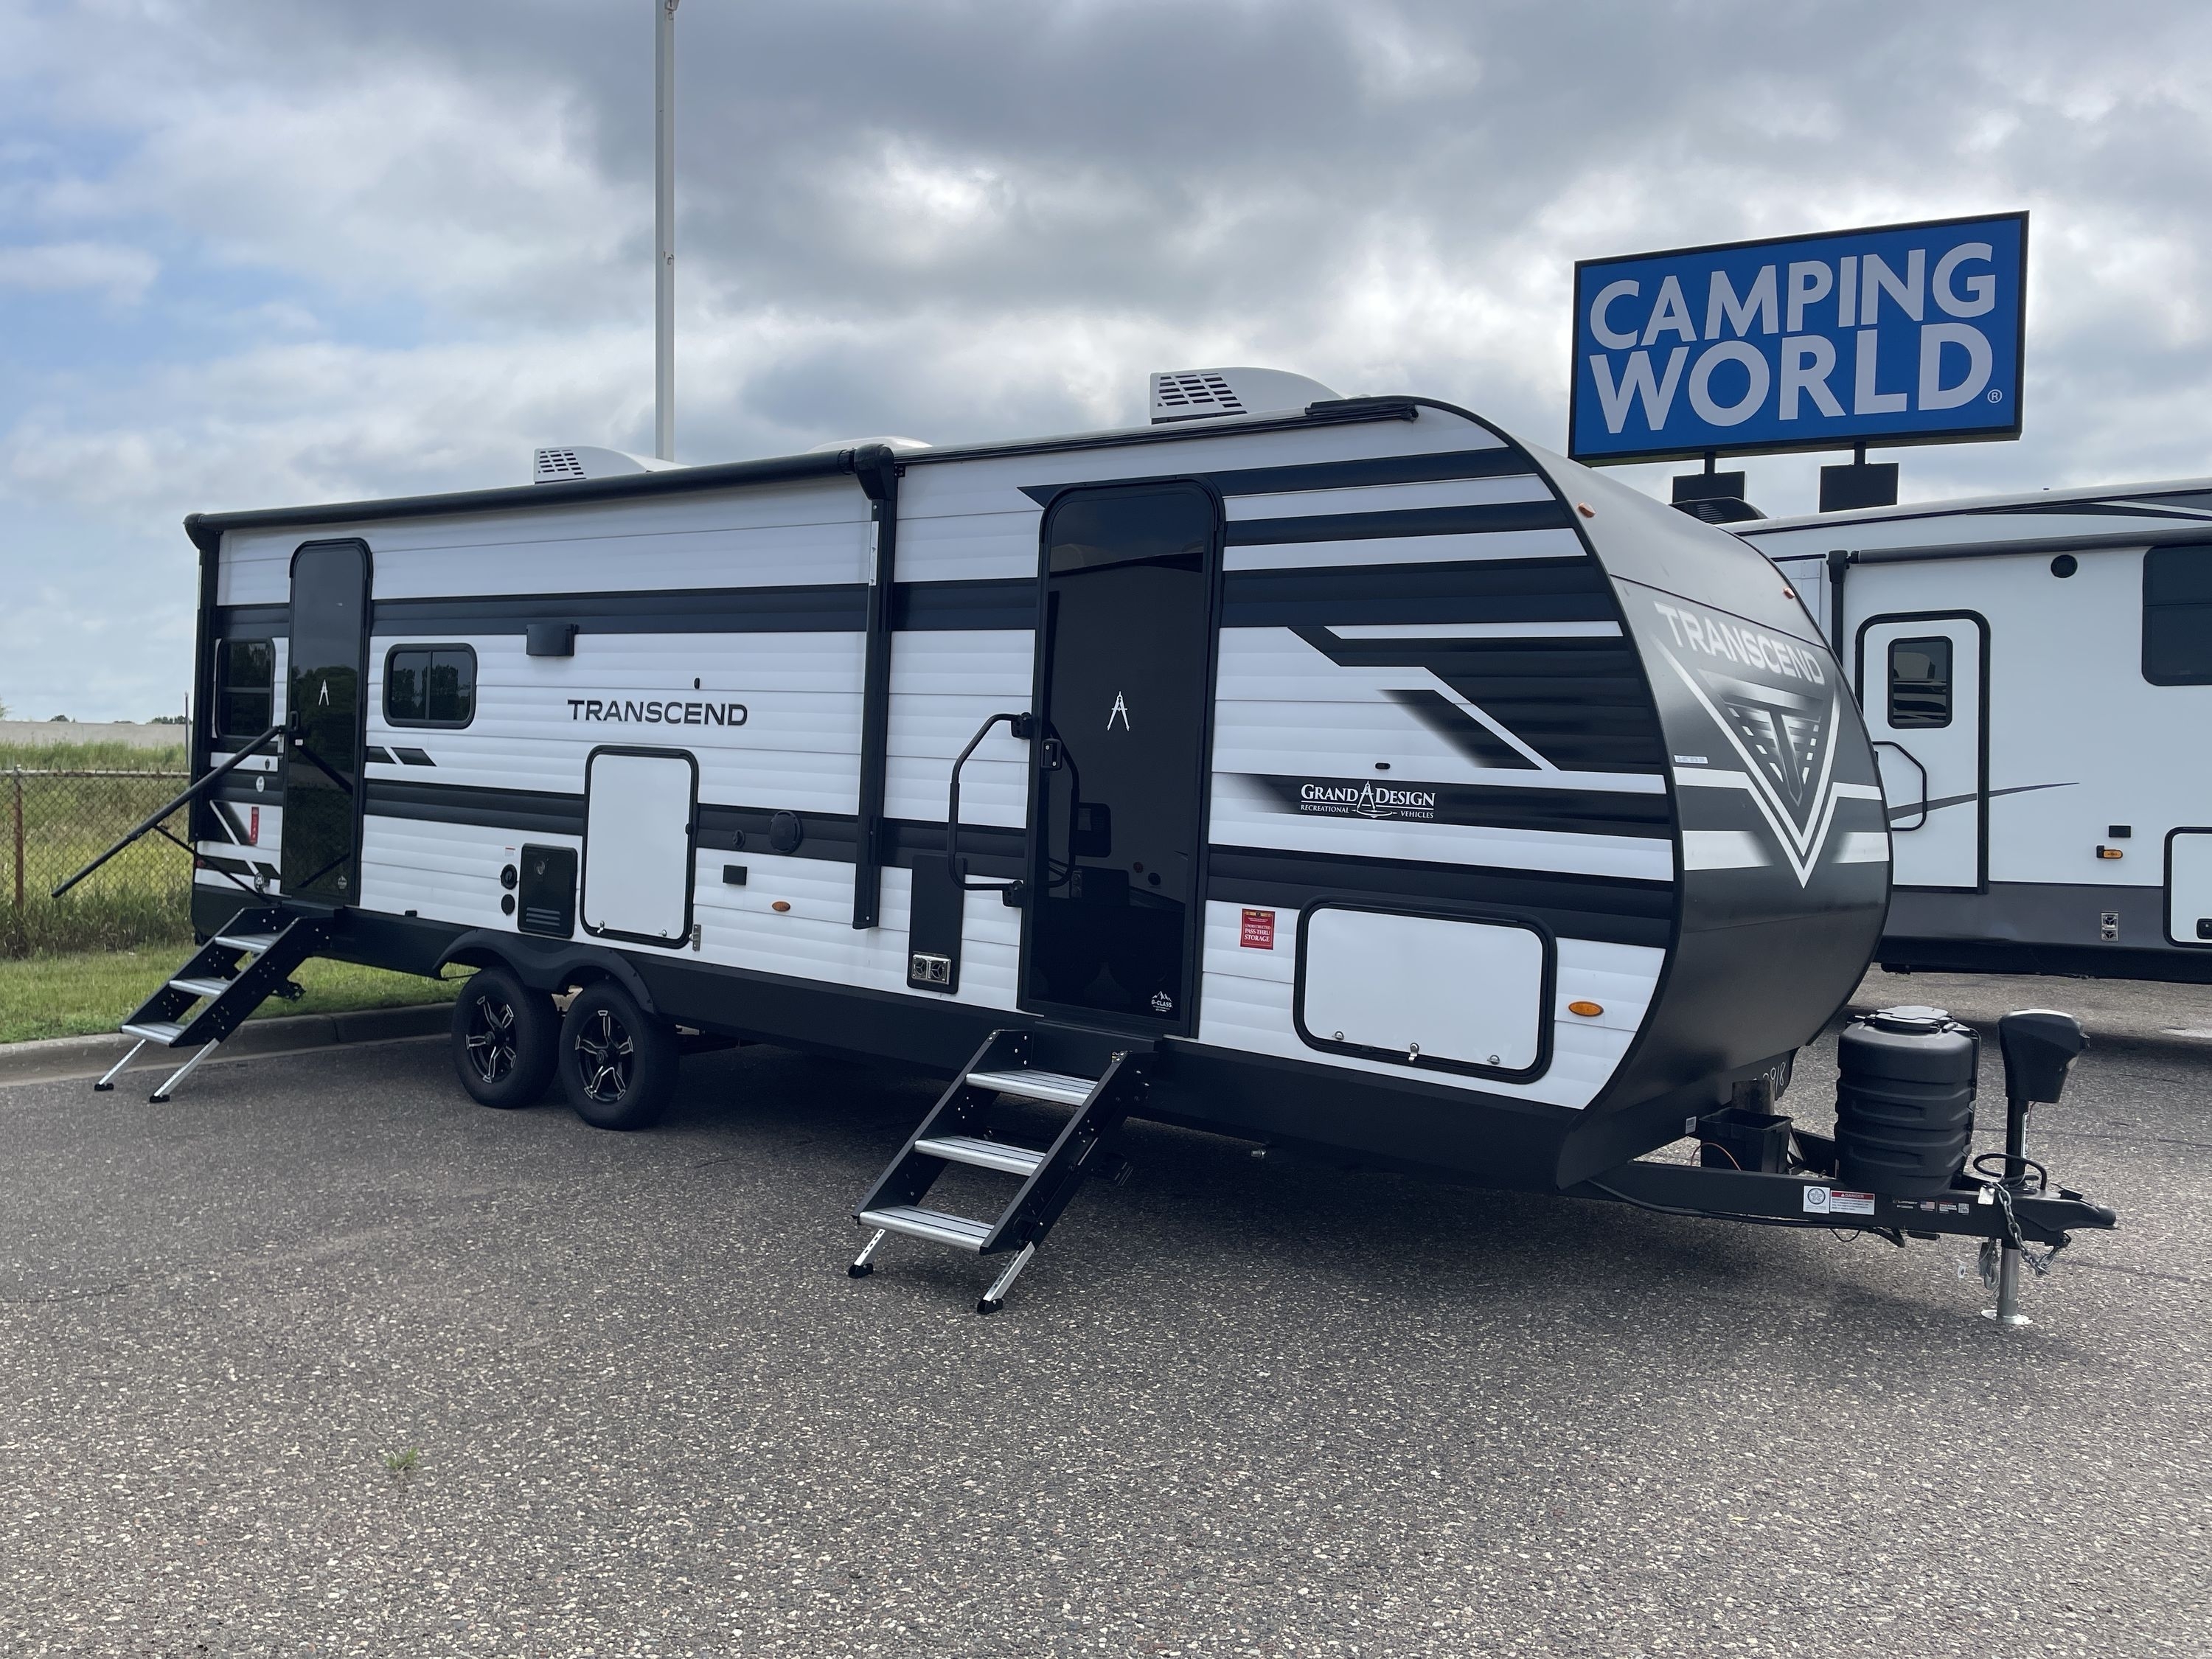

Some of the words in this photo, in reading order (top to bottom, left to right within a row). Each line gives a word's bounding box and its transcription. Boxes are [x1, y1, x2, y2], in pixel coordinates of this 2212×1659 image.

[1590, 242, 1997, 350] CAMPING
[1653, 600, 1826, 686] TRANSCEND
[567, 699, 748, 726] TRANSCEND
[1301, 783, 1359, 802] GRAND
[1374, 787, 1436, 807] DESIGN
[1300, 804, 1350, 813] RECREATIONAL
[1400, 810, 1434, 819] VEHICLES
[1244, 933, 1270, 942] STORAGE
